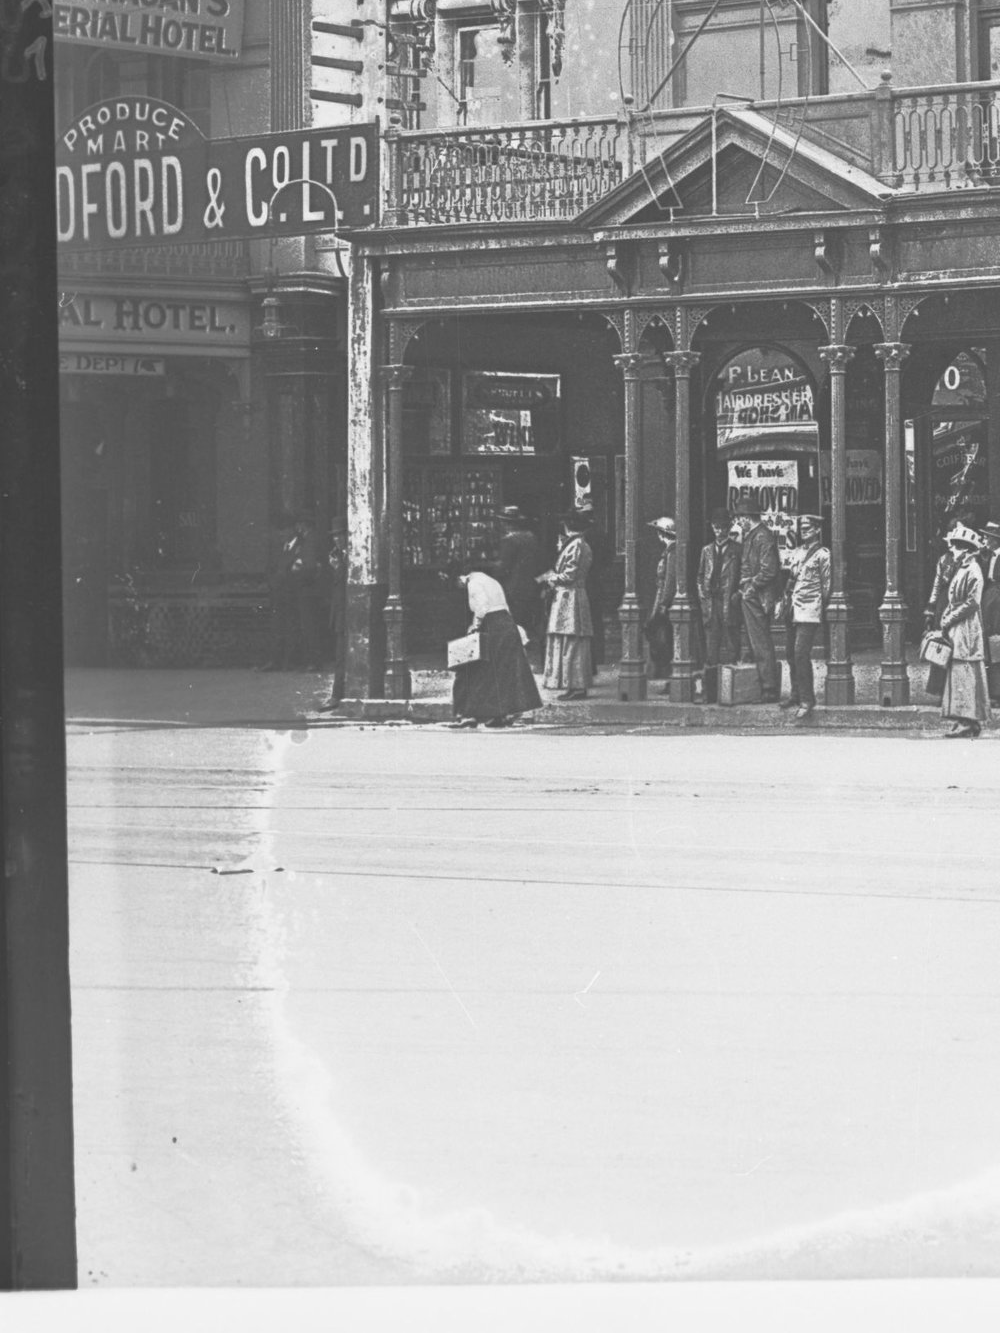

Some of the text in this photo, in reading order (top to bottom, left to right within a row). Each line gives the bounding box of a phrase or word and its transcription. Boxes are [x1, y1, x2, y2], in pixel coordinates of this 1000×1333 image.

[142, 13, 238, 59] HOTEL.
[63, 103, 185, 153] PRODUCE
[87, 130, 177, 156] MART
[57, 155, 184, 243] DFORD
[203, 167, 226, 229] &
[746, 365, 796, 384] LEAN
[734, 463, 785, 479] We have
